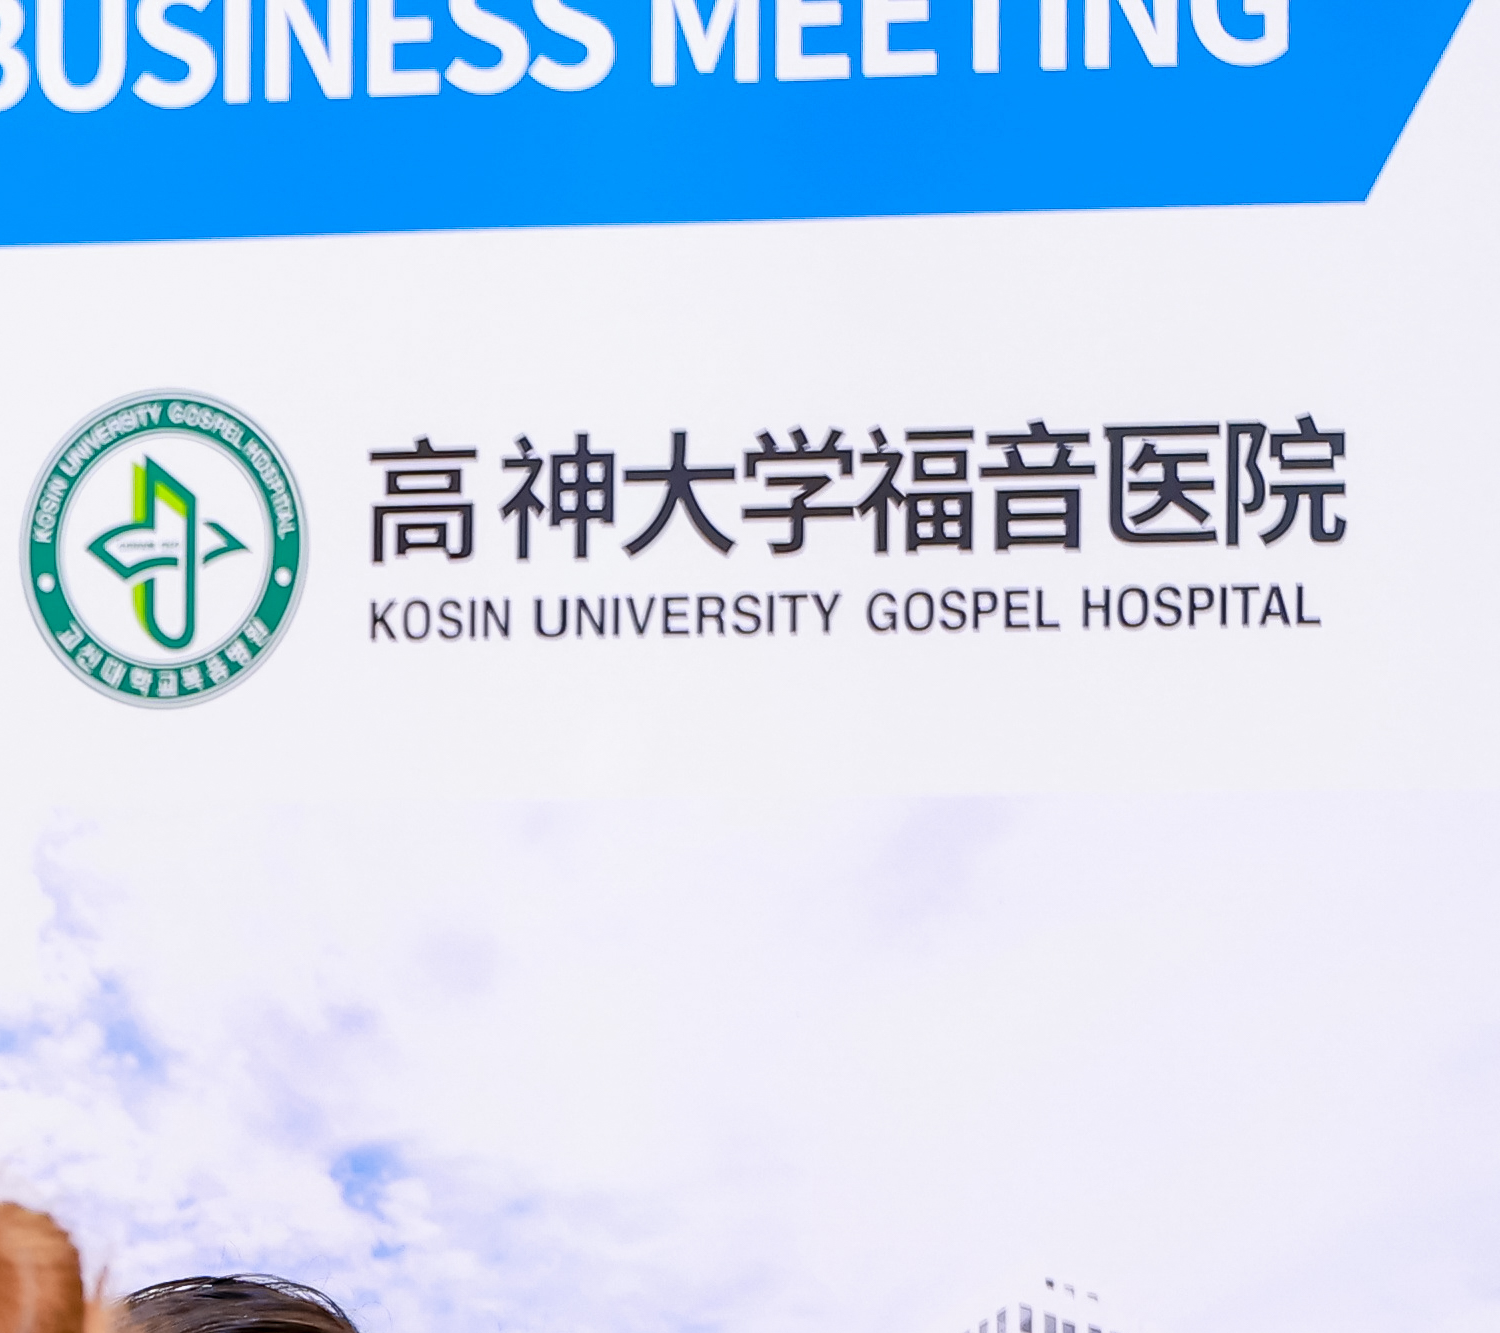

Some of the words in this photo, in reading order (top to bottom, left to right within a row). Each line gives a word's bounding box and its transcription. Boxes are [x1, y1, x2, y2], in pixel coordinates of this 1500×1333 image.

[650, 0, 1290, 87] MEETING
[368, 413, 1347, 562] 高神大学福音医院
[369, 597, 511, 642] KOSIN
[534, 592, 841, 638] UNIVERSITY
[866, 587, 1061, 633] GOSPEL
[1081, 582, 1322, 631] HOSPITAL
